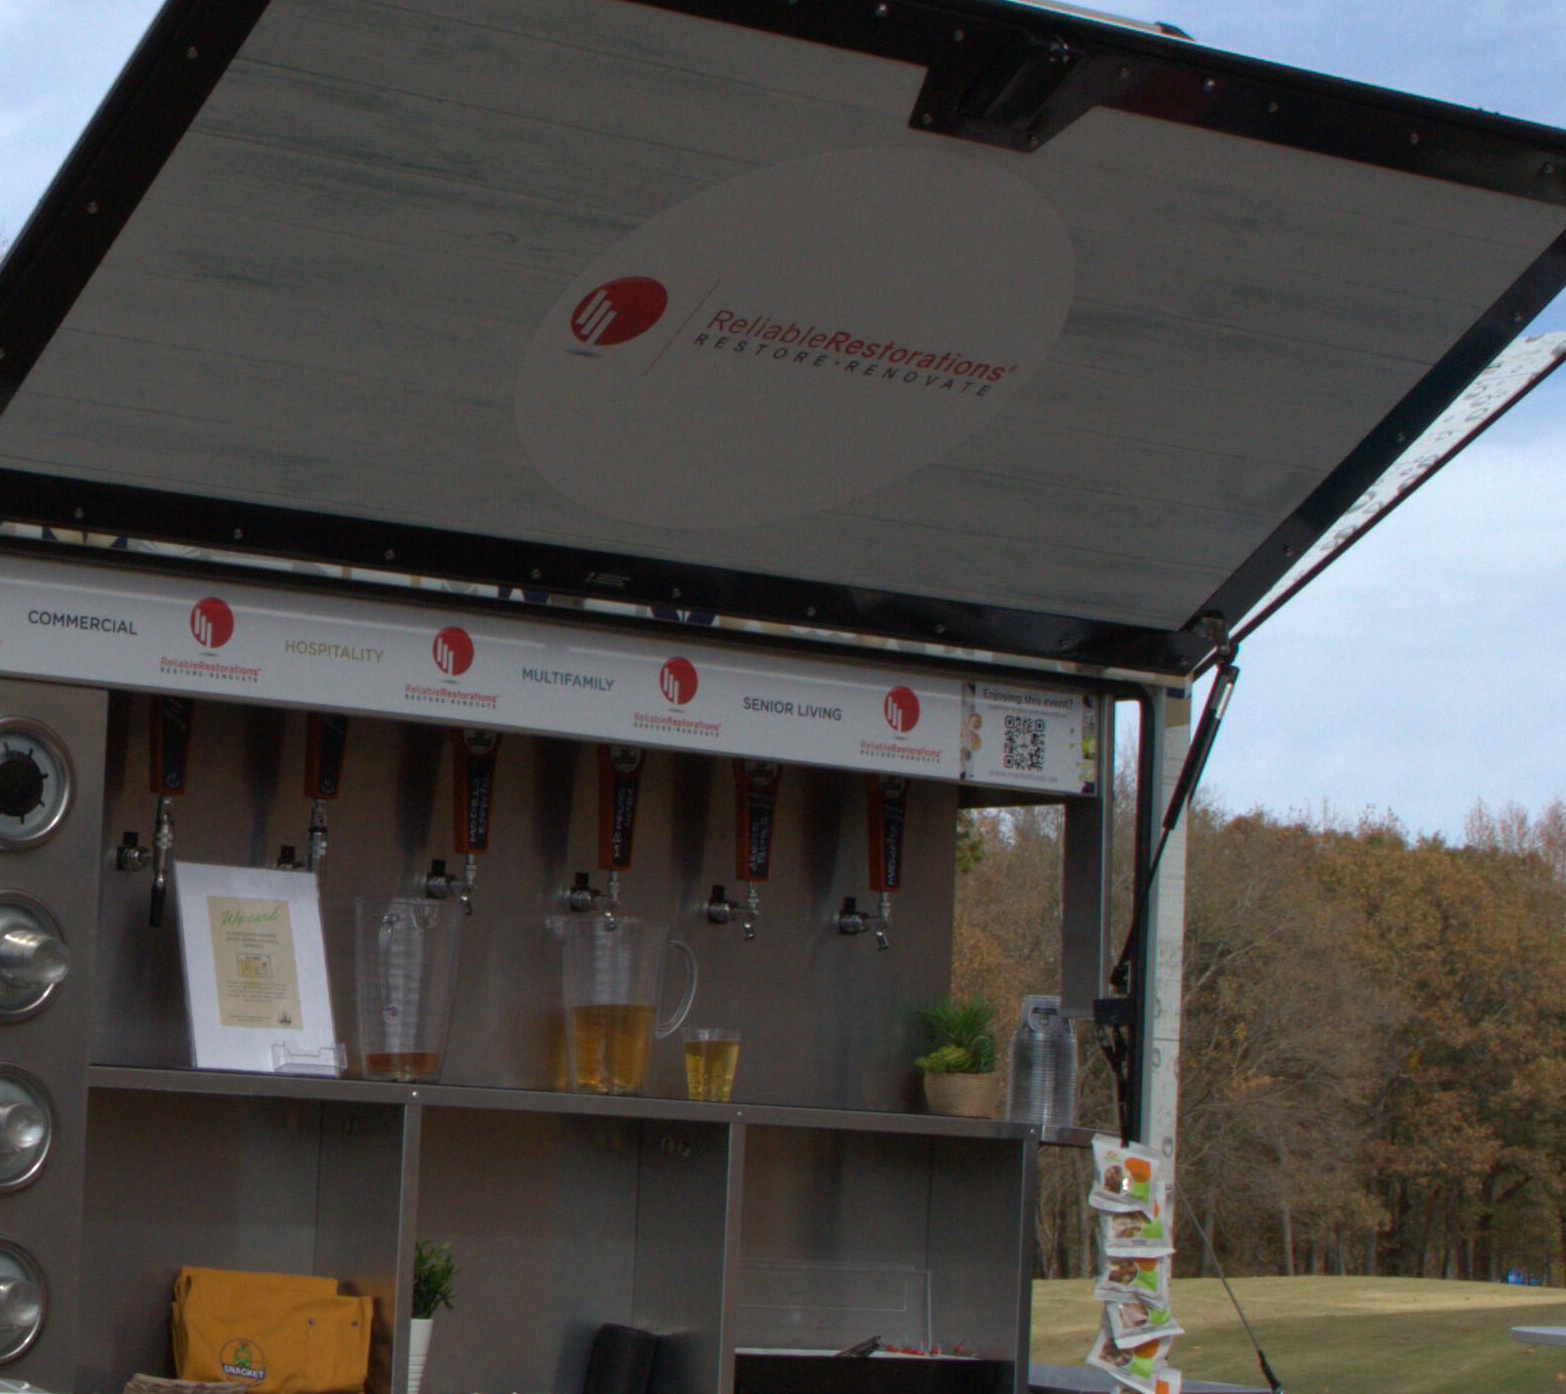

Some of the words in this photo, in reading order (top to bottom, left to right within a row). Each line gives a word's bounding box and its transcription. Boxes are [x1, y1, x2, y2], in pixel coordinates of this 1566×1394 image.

[28, 610, 138, 635] COMMERCIAL
[285, 639, 384, 663] HOSPITALITY
[522, 668, 614, 691] MULTIFAMILY
[743, 697, 793, 715] SENIOR
[798, 704, 842, 721] LIVING
[984, 689, 1022, 705] Enjoying
[1024, 694, 1041, 705] this
[1043, 698, 1074, 709] event?
[223, 1365, 264, 1378] SNACKET
